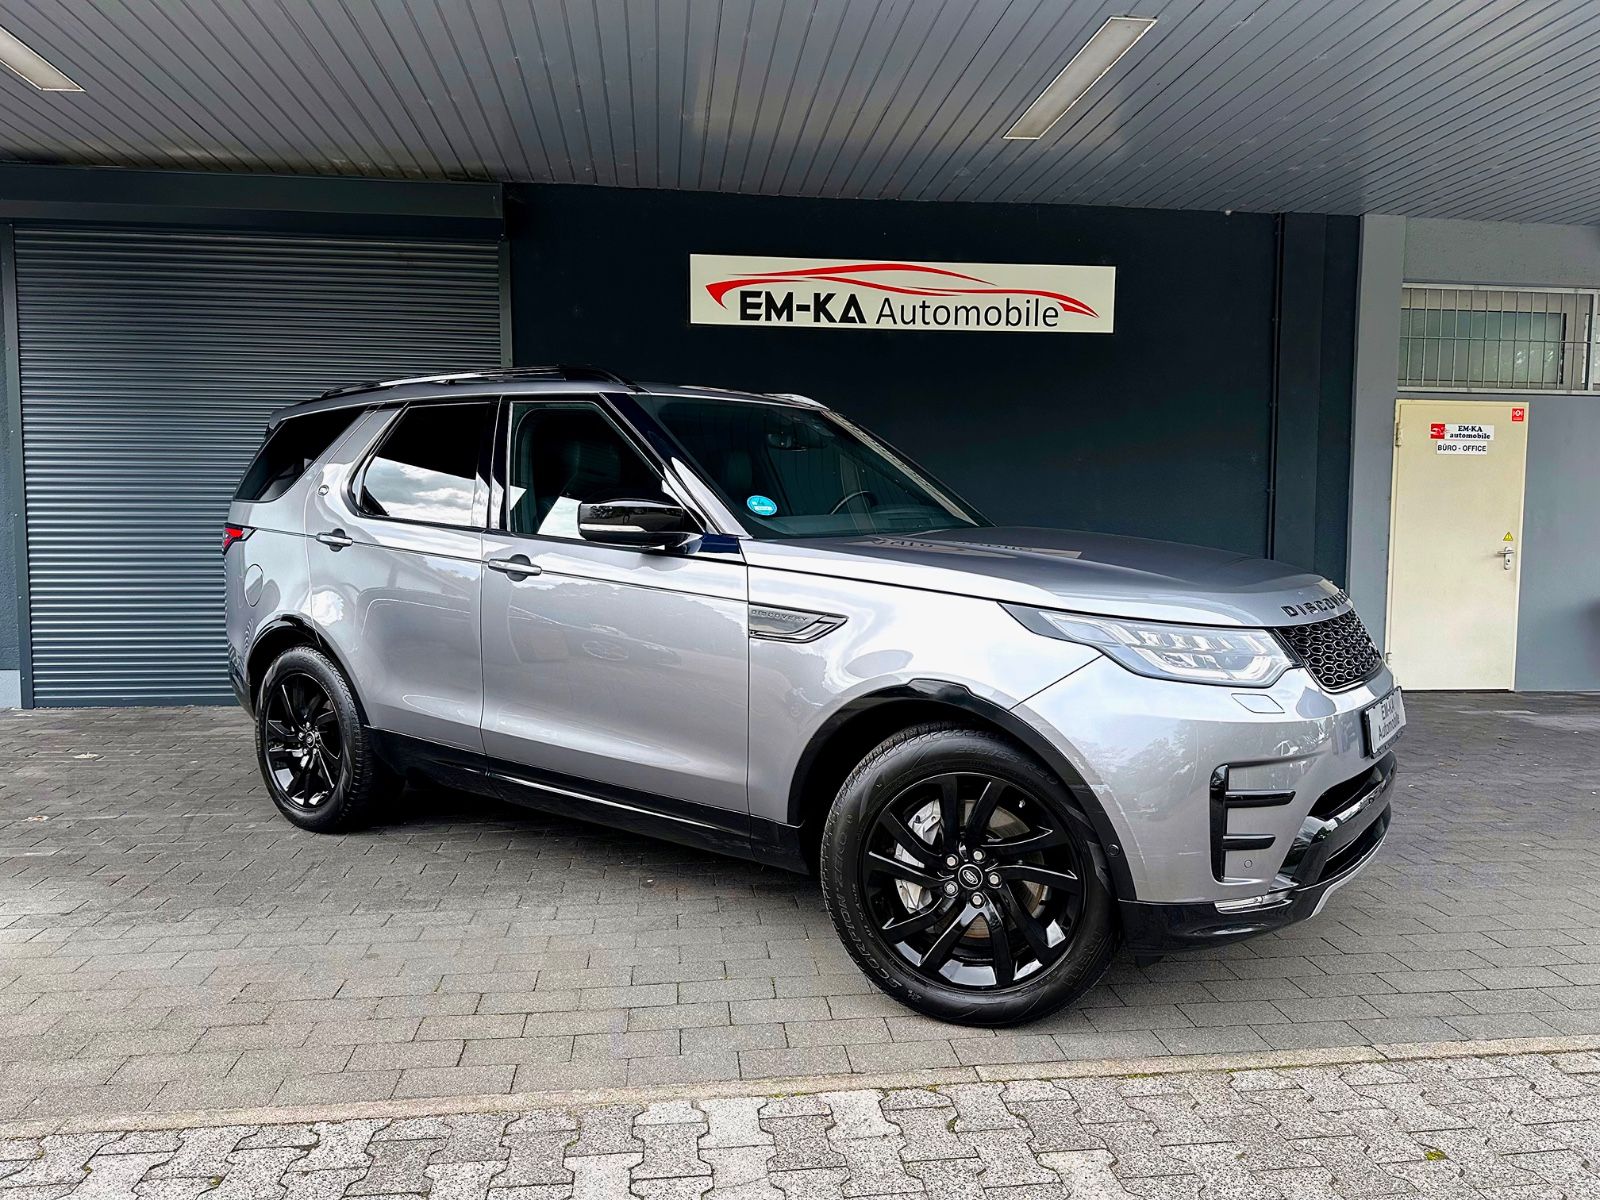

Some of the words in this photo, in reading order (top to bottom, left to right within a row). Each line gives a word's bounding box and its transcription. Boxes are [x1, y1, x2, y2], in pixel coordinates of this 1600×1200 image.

[738, 290, 867, 324] EM-KA
[875, 297, 1060, 328] Automobile
[1449, 432, 1491, 440] automobile
[1457, 425, 1483, 433] EM-KA
[1437, 444, 1457, 452] BÜRO
[1462, 444, 1487, 452] OFFICE
[1281, 590, 1350, 617] DISCOVER
[837, 893, 902, 989] SCORPION
